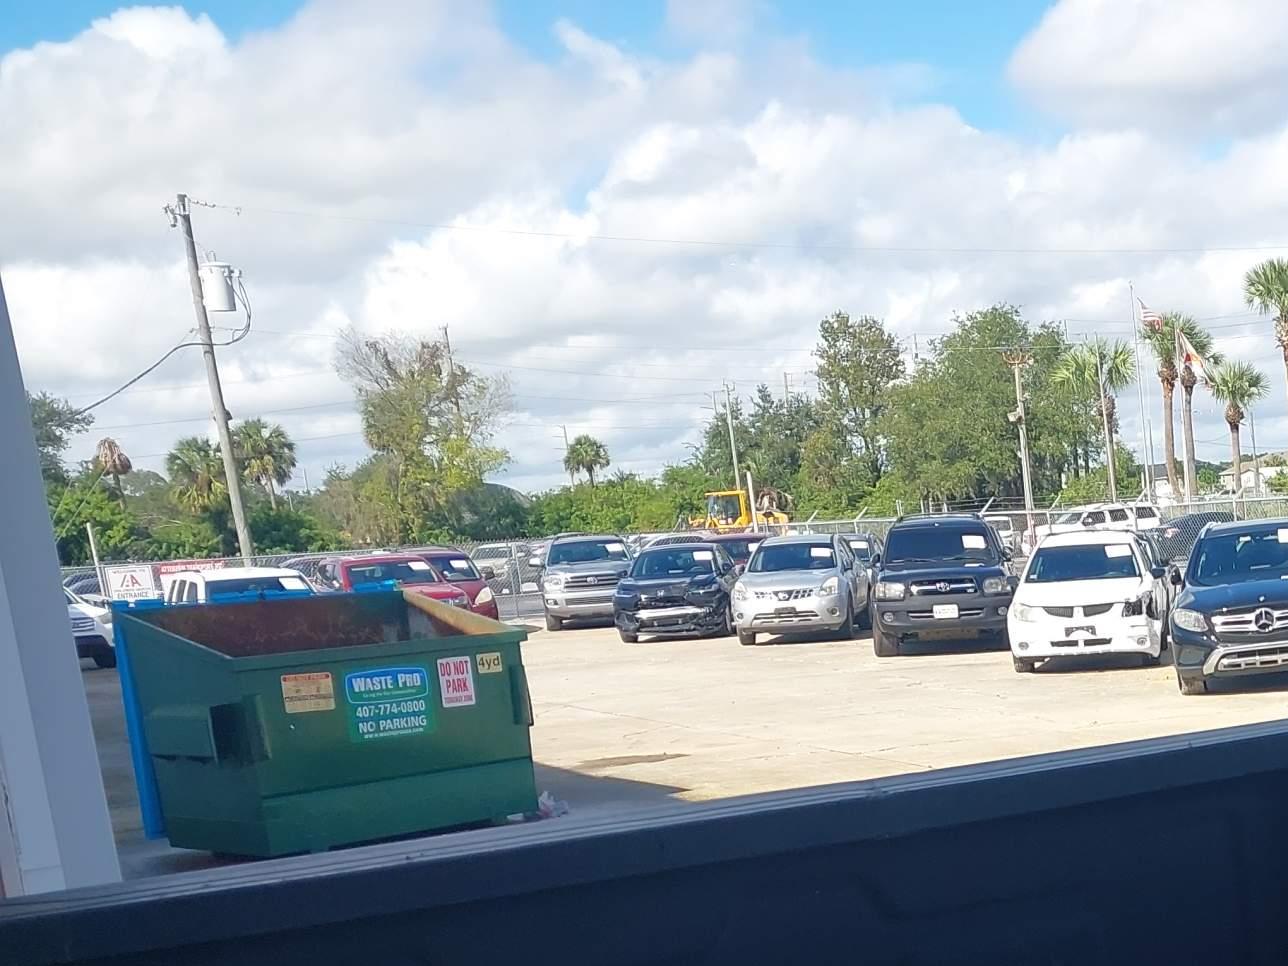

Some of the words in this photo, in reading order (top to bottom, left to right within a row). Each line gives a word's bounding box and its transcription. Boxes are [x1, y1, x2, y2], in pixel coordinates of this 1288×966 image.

[117, 592, 150, 600] ENTRANCE
[440, 662, 451, 677] DO
[453, 660, 469, 676] NOT
[478, 655, 500, 670] 4yd
[351, 675, 394, 693] WASTE
[446, 677, 469, 694] PARK
[356, 699, 426, 718] 407-774-0800
[358, 721, 376, 734] NO
[379, 715, 427, 731] PARKING
